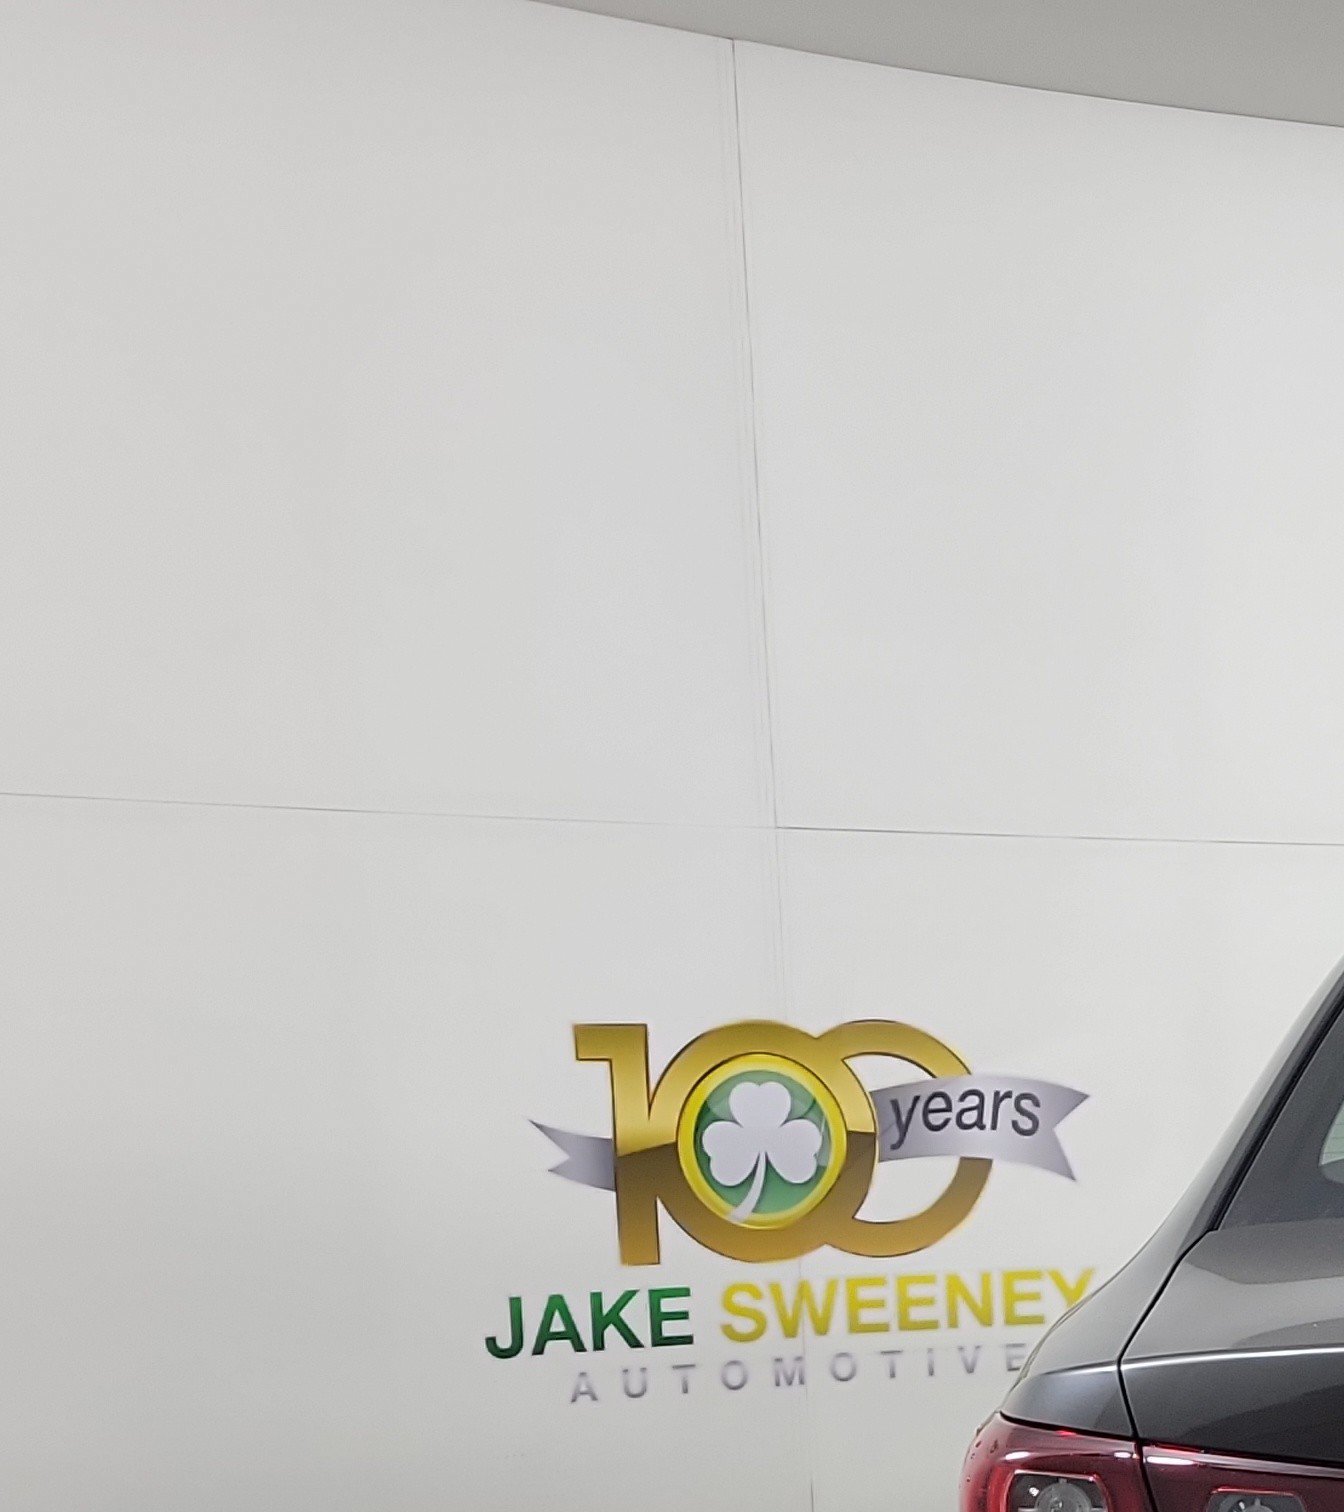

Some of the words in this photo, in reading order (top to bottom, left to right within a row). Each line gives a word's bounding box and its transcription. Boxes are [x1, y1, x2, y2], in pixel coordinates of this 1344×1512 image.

[889, 1086, 1041, 1150] years
[485, 1286, 695, 1360] JAKE
[719, 1267, 1096, 1343] SWEENEY
[570, 1343, 1026, 1403] AUTOMOTIVE
